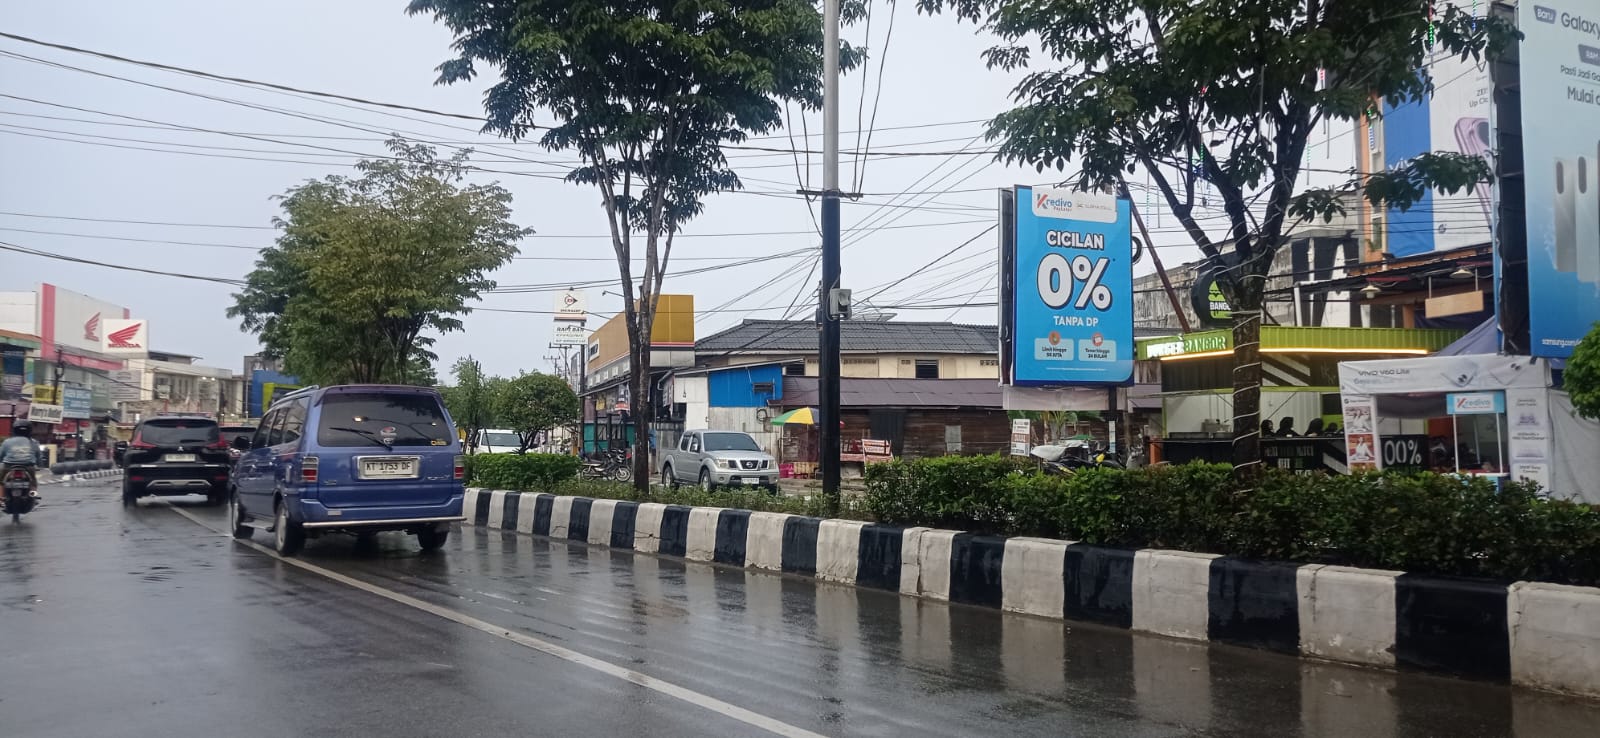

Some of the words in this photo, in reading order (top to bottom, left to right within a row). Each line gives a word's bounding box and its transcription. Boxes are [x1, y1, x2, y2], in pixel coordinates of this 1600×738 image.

[1561, 12, 1600, 40] Galaxy
[1560, 65, 1577, 76] Pasti
[1592, 72, 1600, 82] Ga
[1567, 86, 1594, 104] Mulai
[1037, 193, 1072, 209] Kredivo
[1046, 229, 1104, 250] CICILAN
[1037, 253, 1113, 312] 0%
[1053, 315, 1084, 326] TANPA
[1086, 317, 1099, 327] DP
[1184, 336, 1227, 353] BANGOR
[366, 462, 375, 471] KT
[379, 462, 399, 471] 1753
[401, 461, 411, 470] DF
